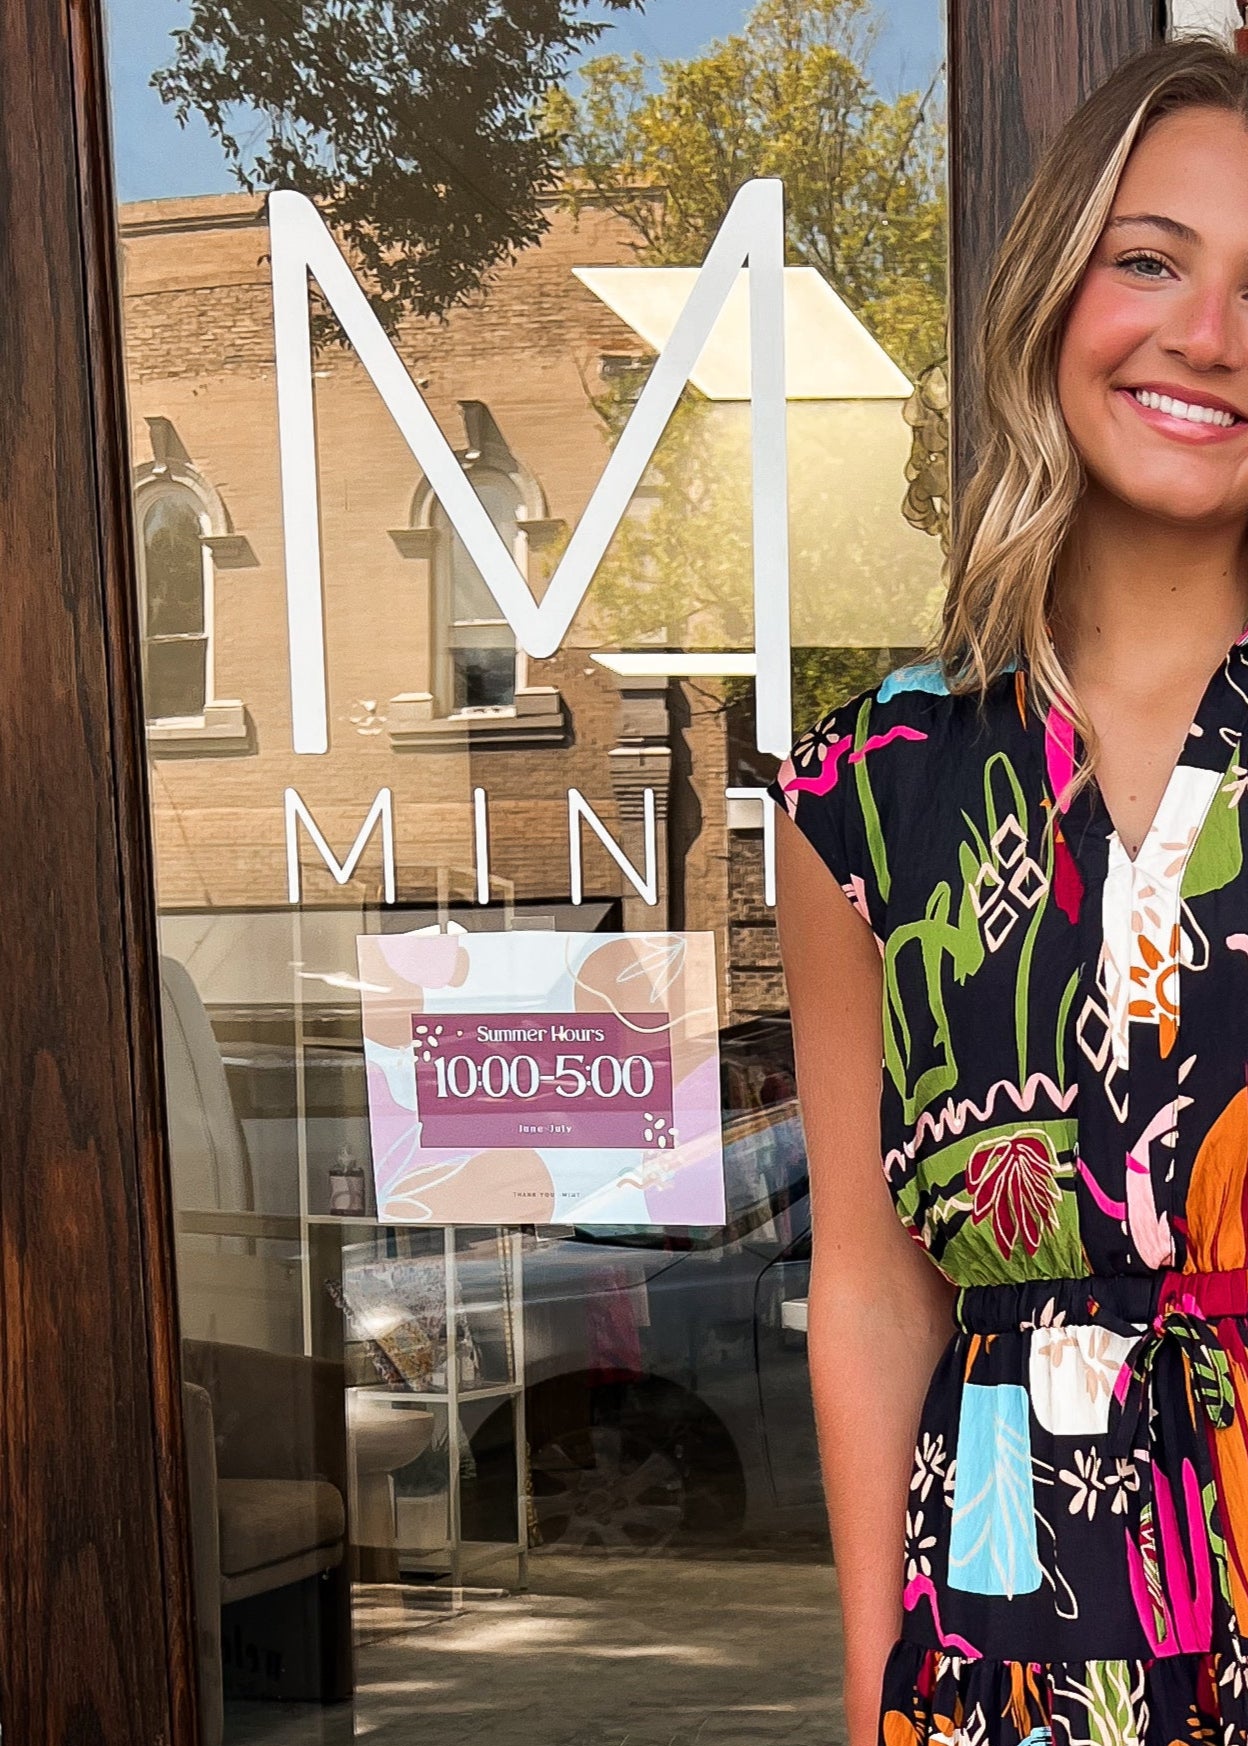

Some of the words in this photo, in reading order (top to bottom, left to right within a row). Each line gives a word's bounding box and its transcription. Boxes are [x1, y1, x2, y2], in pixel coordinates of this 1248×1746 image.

[267, 177, 793, 756] M
[284, 787, 777, 907] MINT
[476, 1025, 547, 1042] Summer
[551, 1025, 605, 1042] Hours
[433, 1054, 655, 1098] 10:00-5:00
